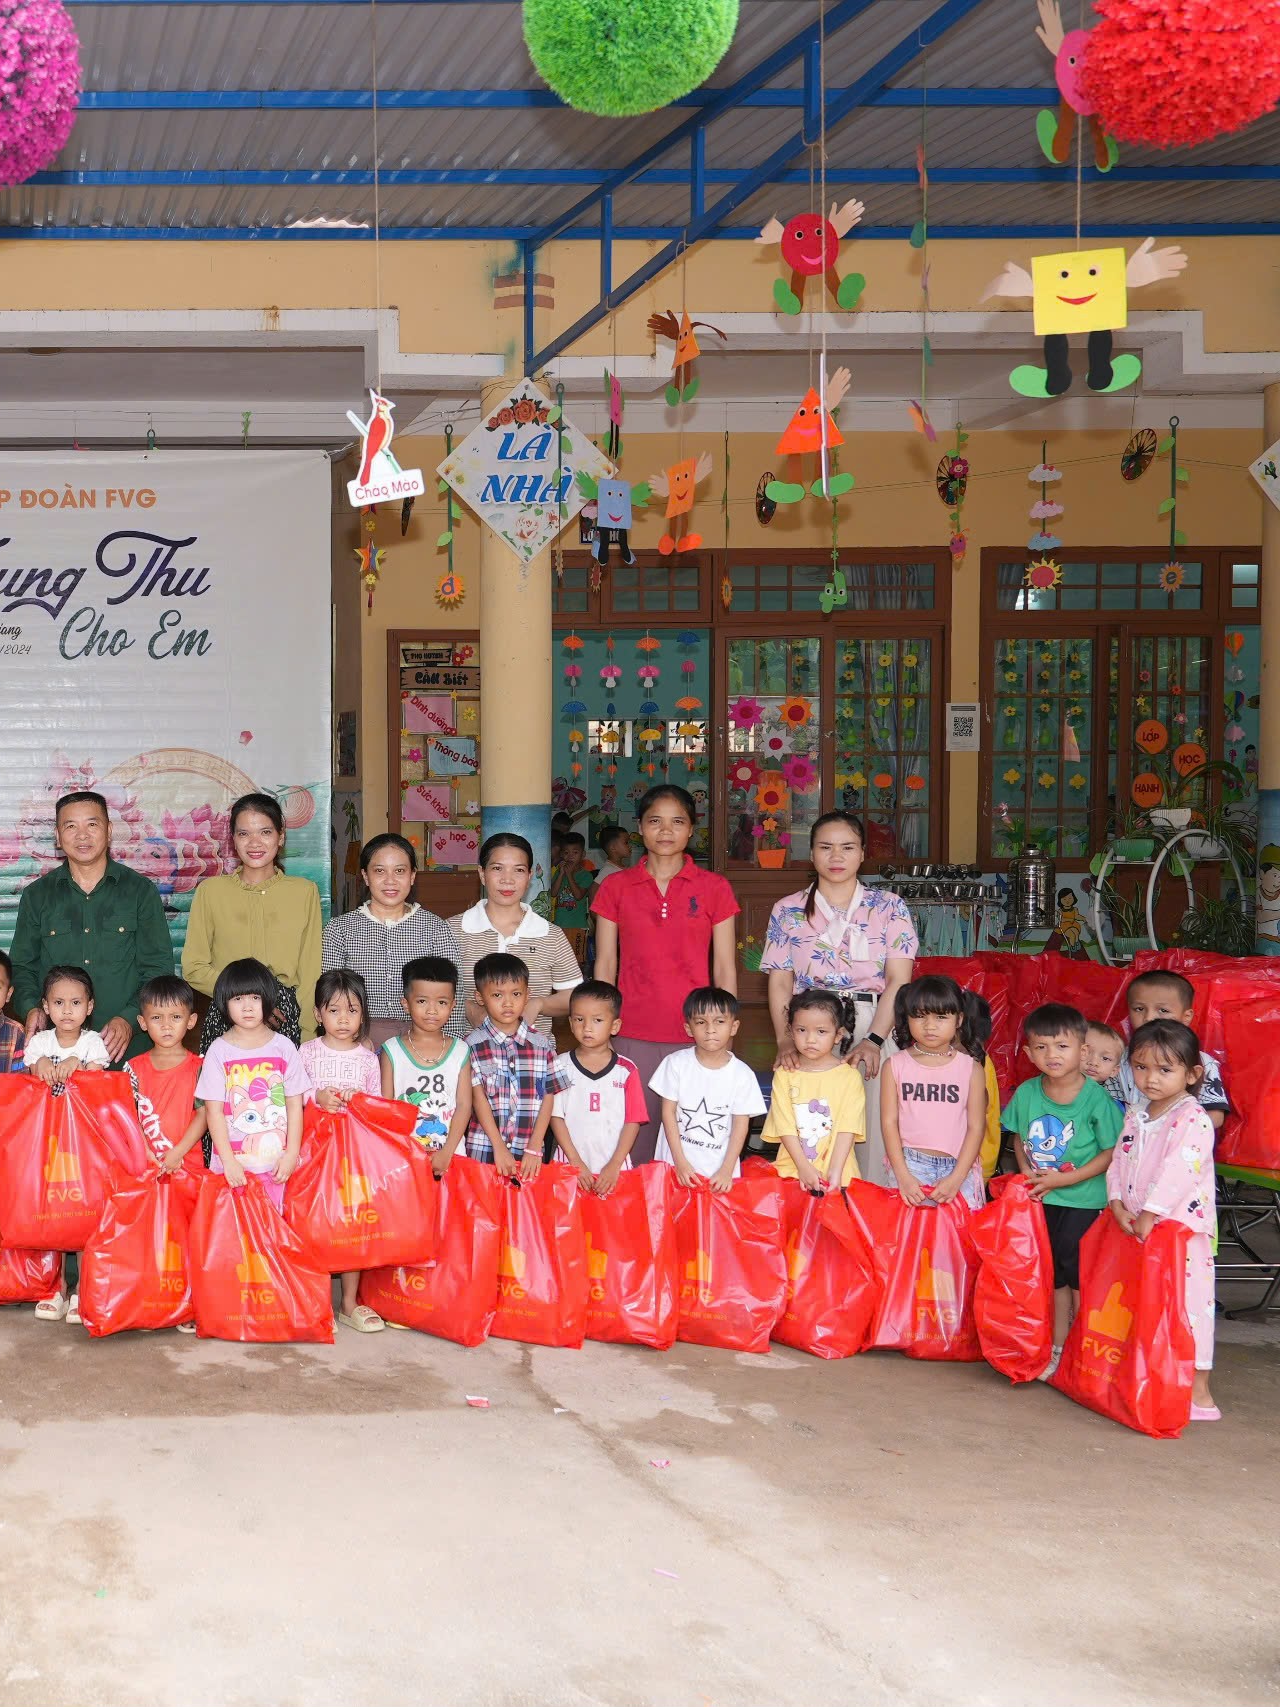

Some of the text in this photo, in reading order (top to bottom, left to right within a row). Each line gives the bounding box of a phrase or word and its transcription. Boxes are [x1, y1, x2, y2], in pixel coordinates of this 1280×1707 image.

[497, 424, 553, 461] LÀ
[19, 483, 96, 508] ĐOÀN
[105, 488, 157, 508] FVG
[480, 467, 573, 503] NHÀ
[95, 530, 211, 606] Thu
[58, 606, 212, 661] Cho Em
[434, 741, 460, 762] Thông
[449, 831, 467, 842] học
[417, 1073, 445, 1094] 28
[901, 1082, 960, 1104] PARIS
[47, 1187, 83, 1204] FVG
[344, 1207, 379, 1227] FVG
[159, 1278, 185, 1293] FVG
[392, 1270, 426, 1291] FVG
[239, 1287, 276, 1305] FVG
[916, 1306, 959, 1324] FVG
[1081, 1335, 1124, 1365] FVG
